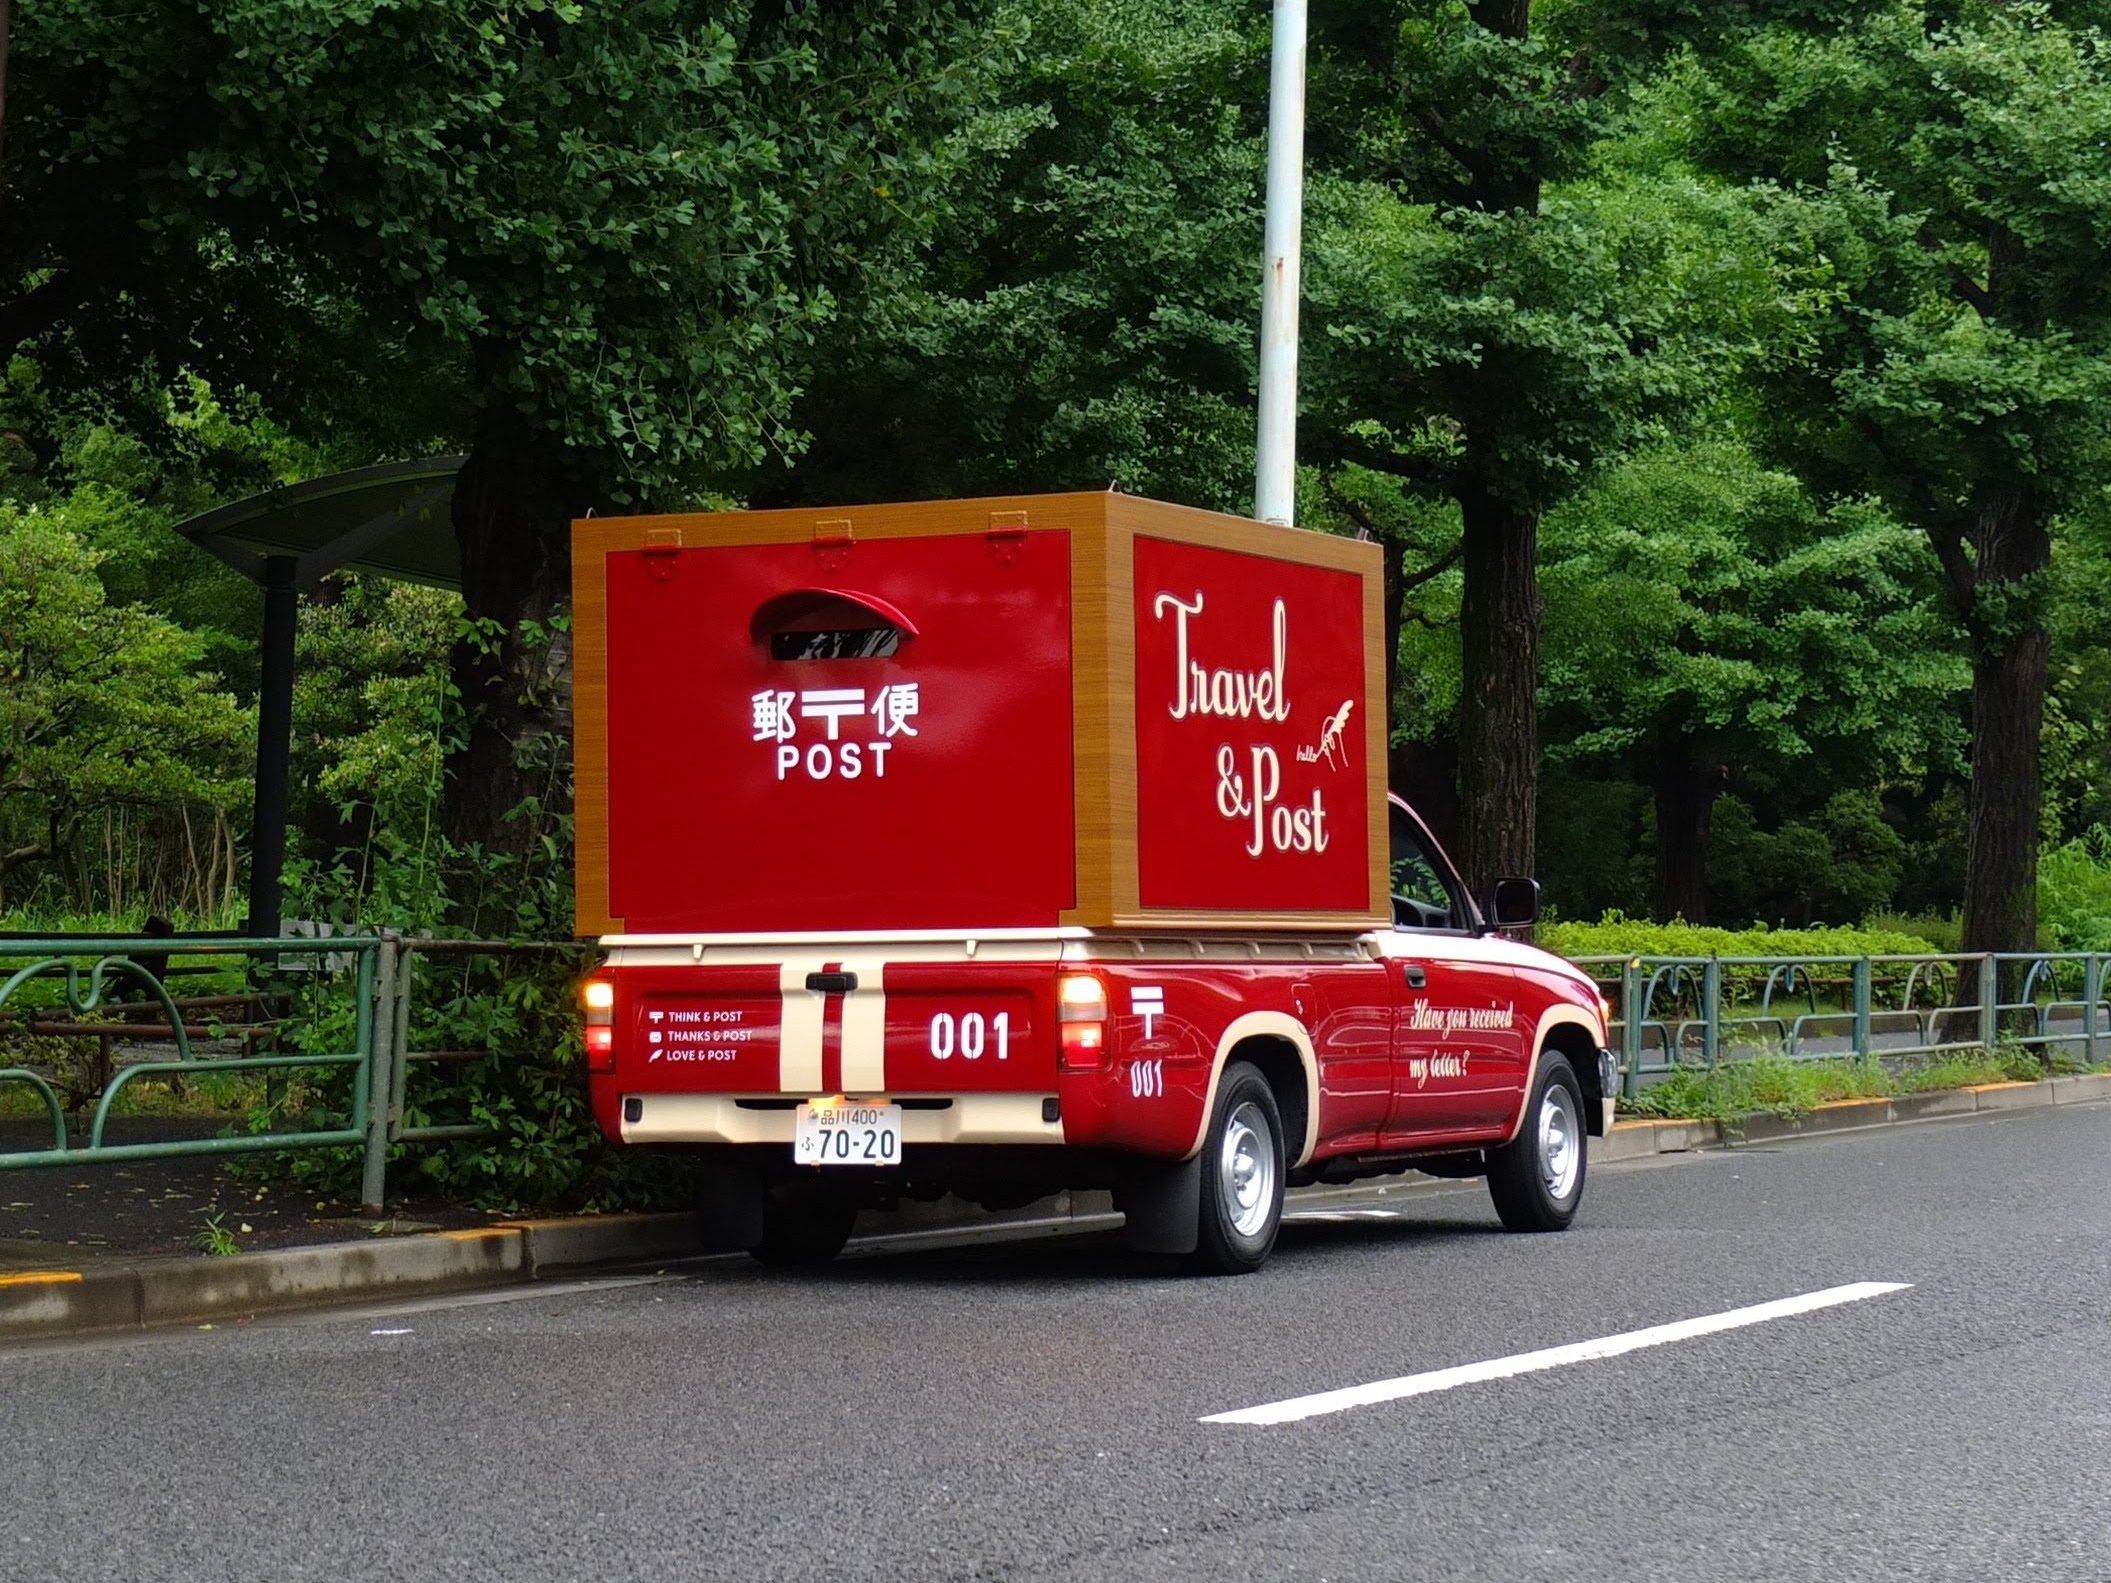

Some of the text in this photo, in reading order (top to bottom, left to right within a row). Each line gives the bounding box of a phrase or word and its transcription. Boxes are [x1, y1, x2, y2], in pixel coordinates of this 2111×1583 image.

[1154, 592, 1291, 722] Travel
[776, 742, 892, 781] POST
[1217, 745, 1329, 857] & Post
[667, 1030, 753, 1042] THANKS & POST
[668, 1011, 743, 1023] THINK & POST
[930, 1012, 1009, 1060] 001
[1410, 998, 1513, 1040] Have you received
[666, 1050, 737, 1061] LOVE & POST
[1409, 1049, 1471, 1090] my letter?
[1130, 1059, 1162, 1097] 001
[818, 1129, 895, 1159] 70-20
